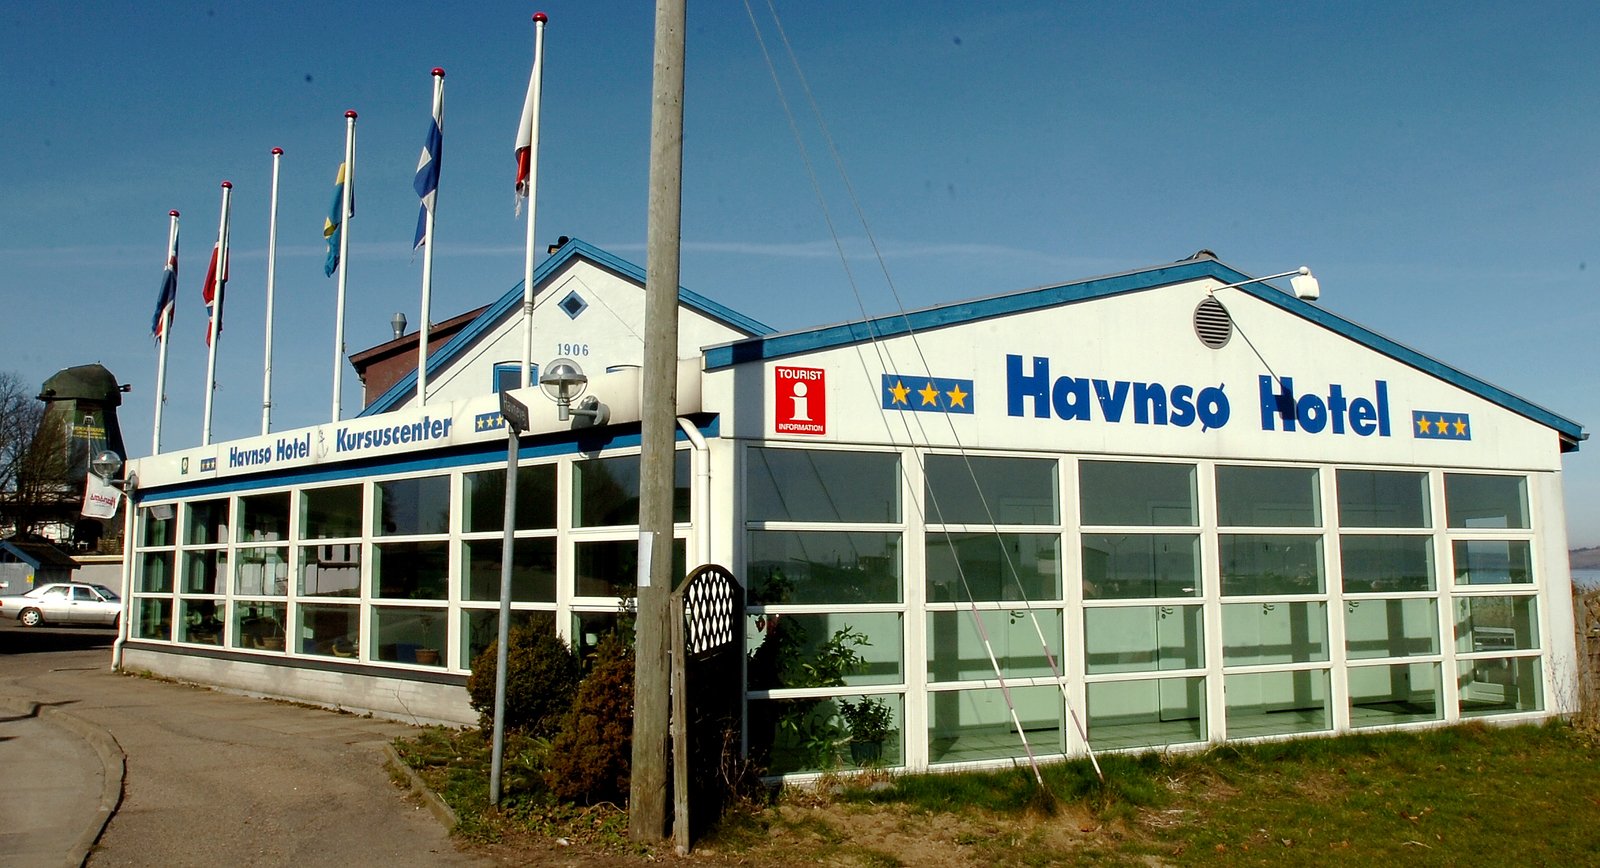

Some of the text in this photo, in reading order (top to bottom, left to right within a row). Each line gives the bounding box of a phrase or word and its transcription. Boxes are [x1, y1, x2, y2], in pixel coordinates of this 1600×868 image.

[558, 343, 589, 356] 1906
[778, 368, 822, 380] TOURIST
[1006, 354, 1391, 437] Havnsø Hotel
[778, 423, 823, 432] INFORMATION
[276, 432, 311, 461] Hotel
[336, 415, 453, 452] Kursuscenter
